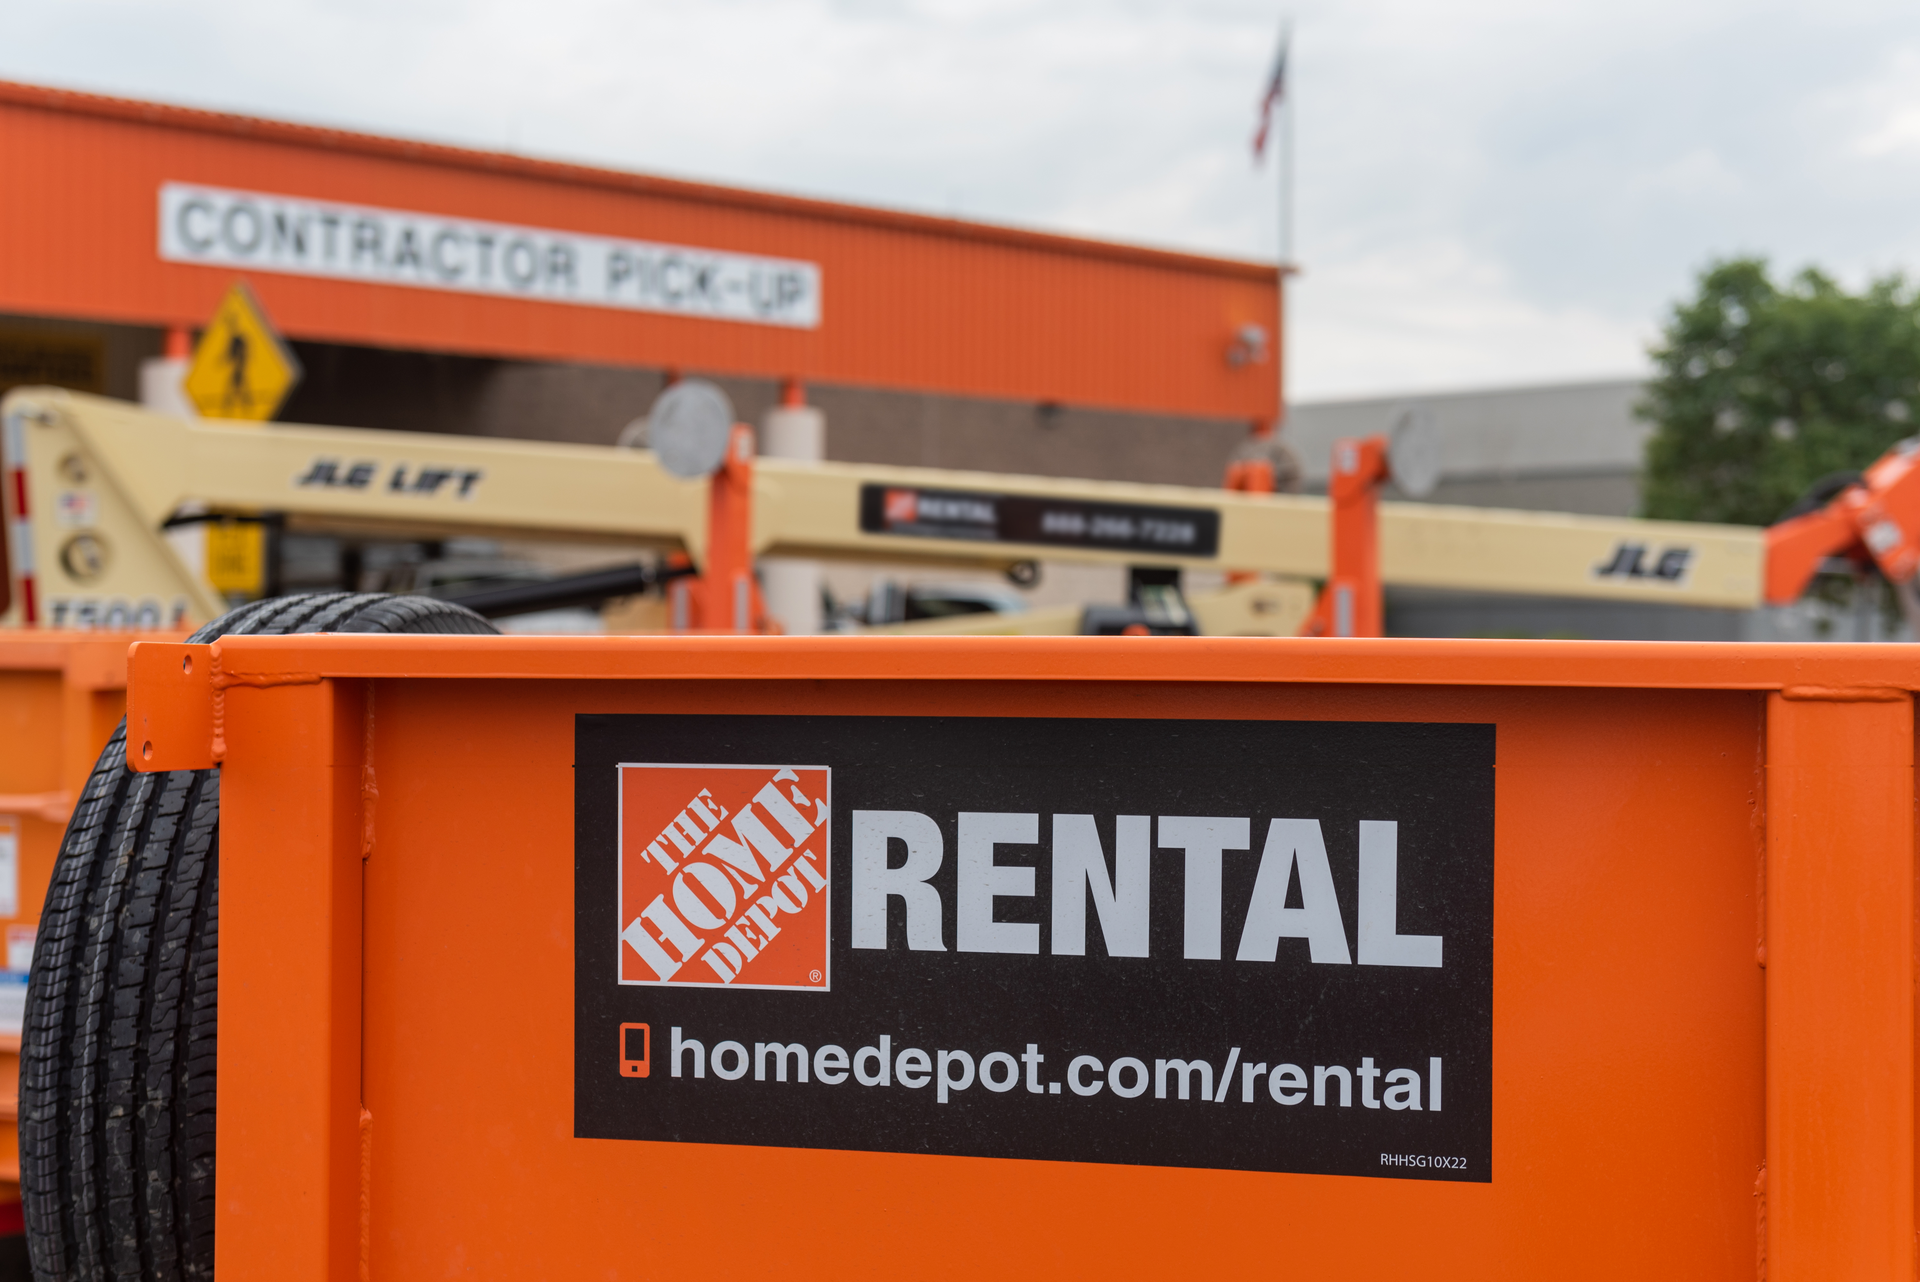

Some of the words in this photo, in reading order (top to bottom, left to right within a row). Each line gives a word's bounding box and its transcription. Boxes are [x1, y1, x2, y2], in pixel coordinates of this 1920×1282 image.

[175, 197, 579, 294] CONTRACTOR
[605, 251, 808, 315] PICK-UP
[388, 463, 484, 500] LIFT
[1594, 544, 1693, 581] JLG
[622, 768, 828, 983] HOME
[640, 787, 729, 876] THE
[700, 848, 828, 984] DEPOT
[851, 809, 1443, 968] RENTAL
[670, 1026, 1442, 1112] homedepot.com/rental
[1380, 1153, 1467, 1169] RHHSG10X22
